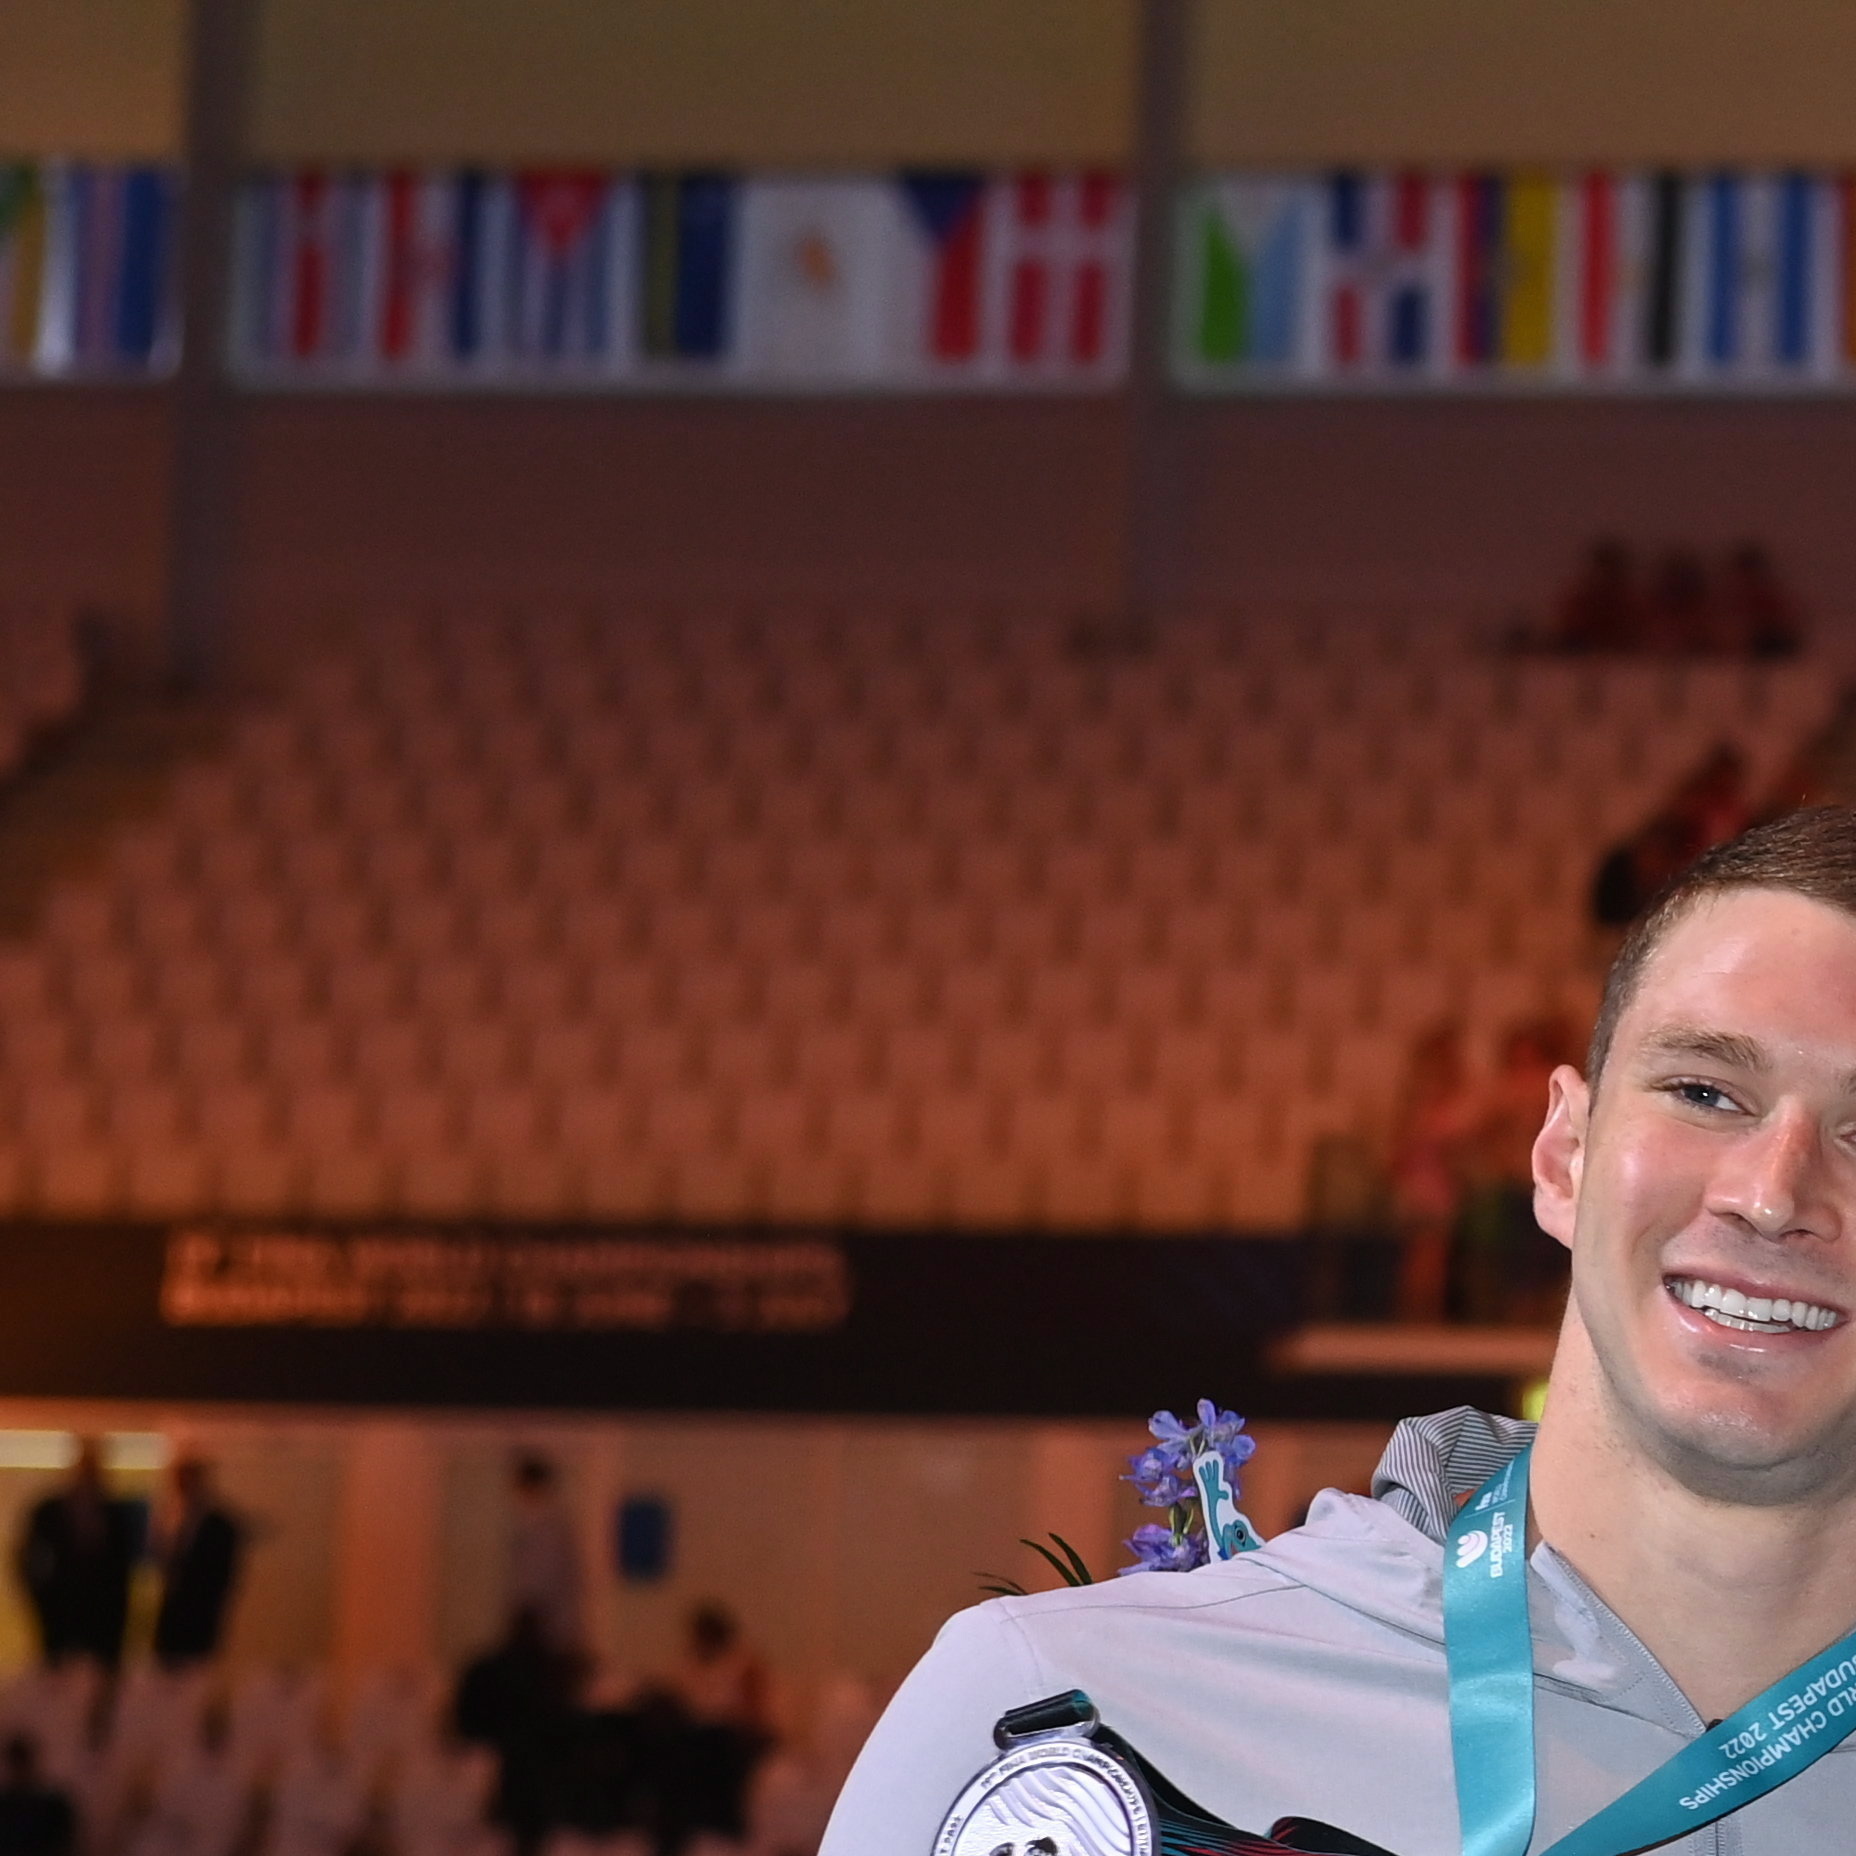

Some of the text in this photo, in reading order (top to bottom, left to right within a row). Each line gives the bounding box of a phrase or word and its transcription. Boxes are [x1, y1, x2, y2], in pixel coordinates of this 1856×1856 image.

[1490, 1512, 1505, 1578] BUDAPEST
[1503, 1524, 1513, 1553] 2022
[1678, 1710, 1828, 1811] CHAMPIONSHIPS
[1718, 1721, 1768, 1760] 2022
